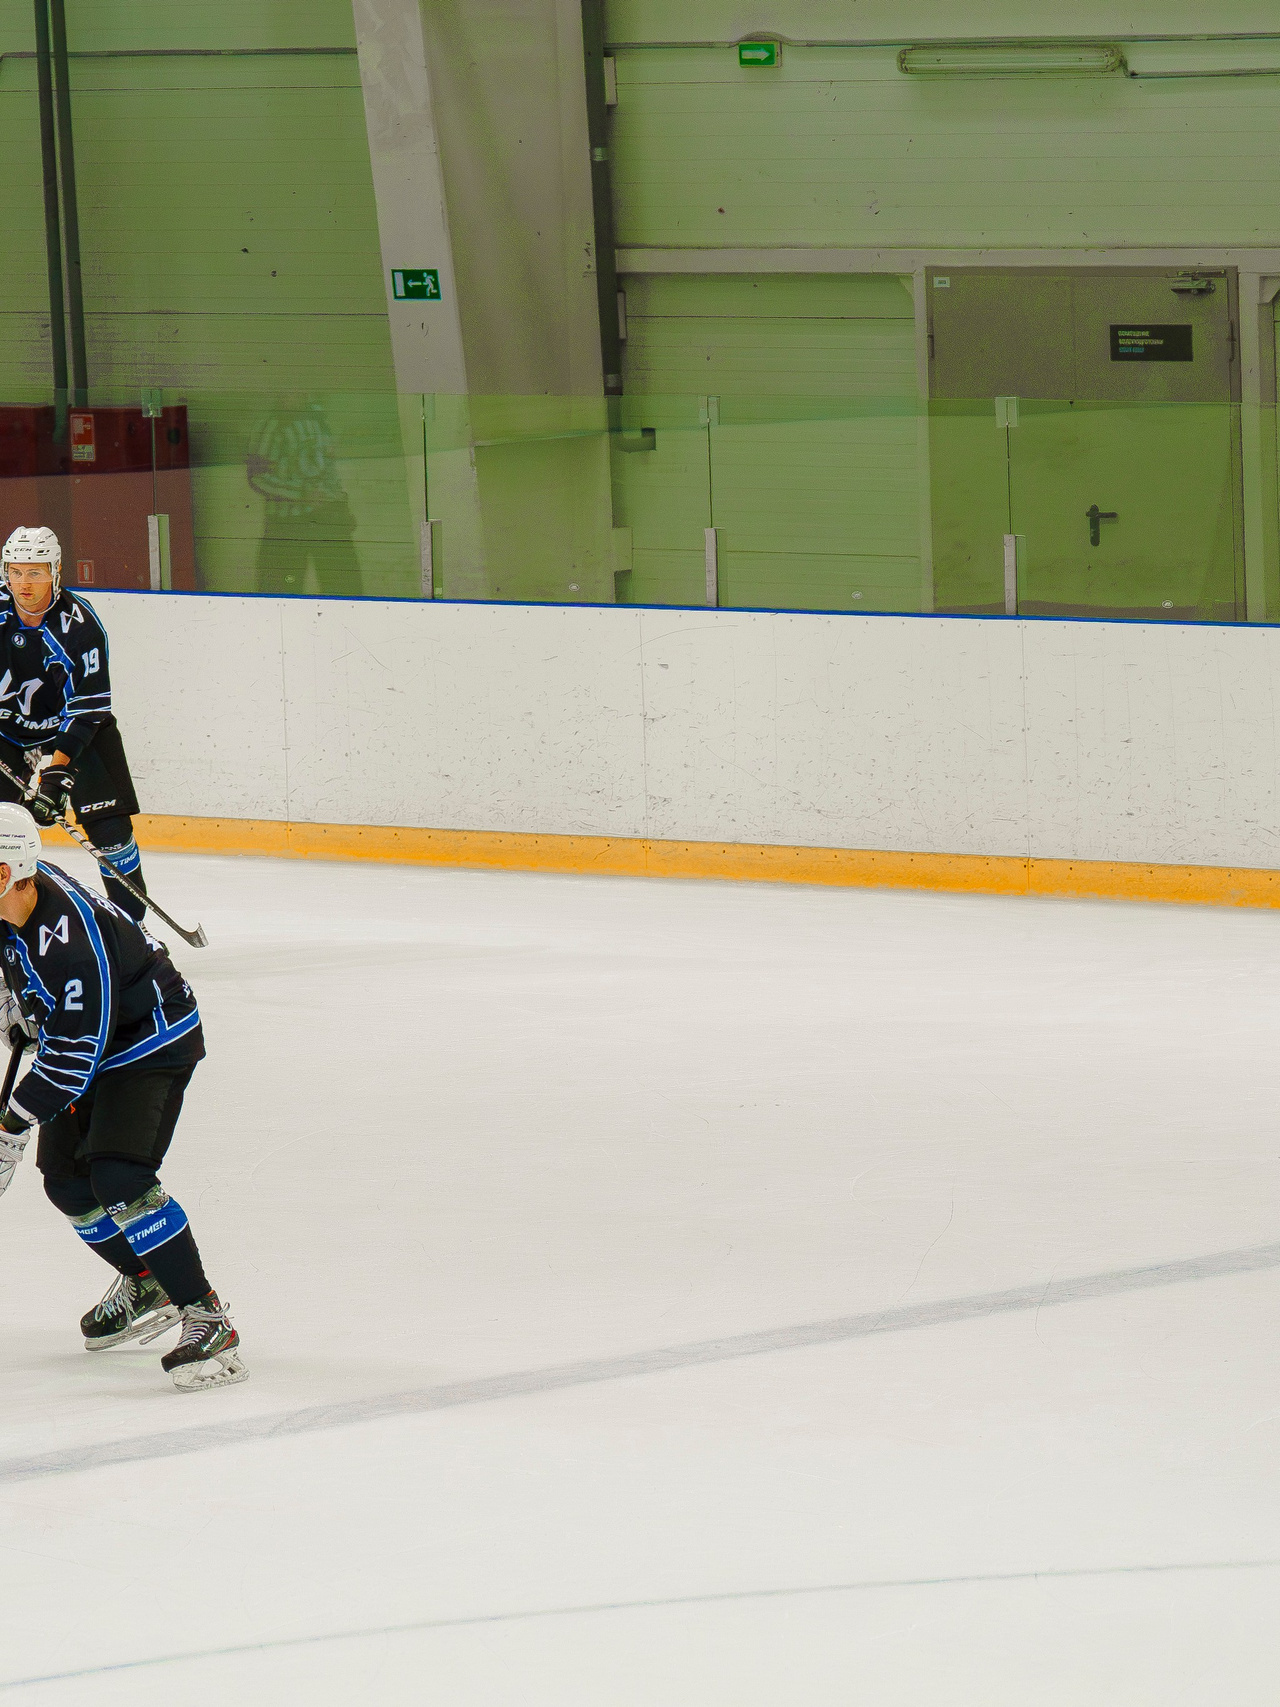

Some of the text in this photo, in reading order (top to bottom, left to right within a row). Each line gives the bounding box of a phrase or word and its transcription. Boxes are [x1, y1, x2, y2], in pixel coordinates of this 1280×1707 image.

[82, 647, 100, 677] 19
[15, 710, 62, 730] TIME
[80, 799, 117, 813] CCM
[64, 979, 84, 1011] 2
[134, 1217, 167, 1241] TIMER
